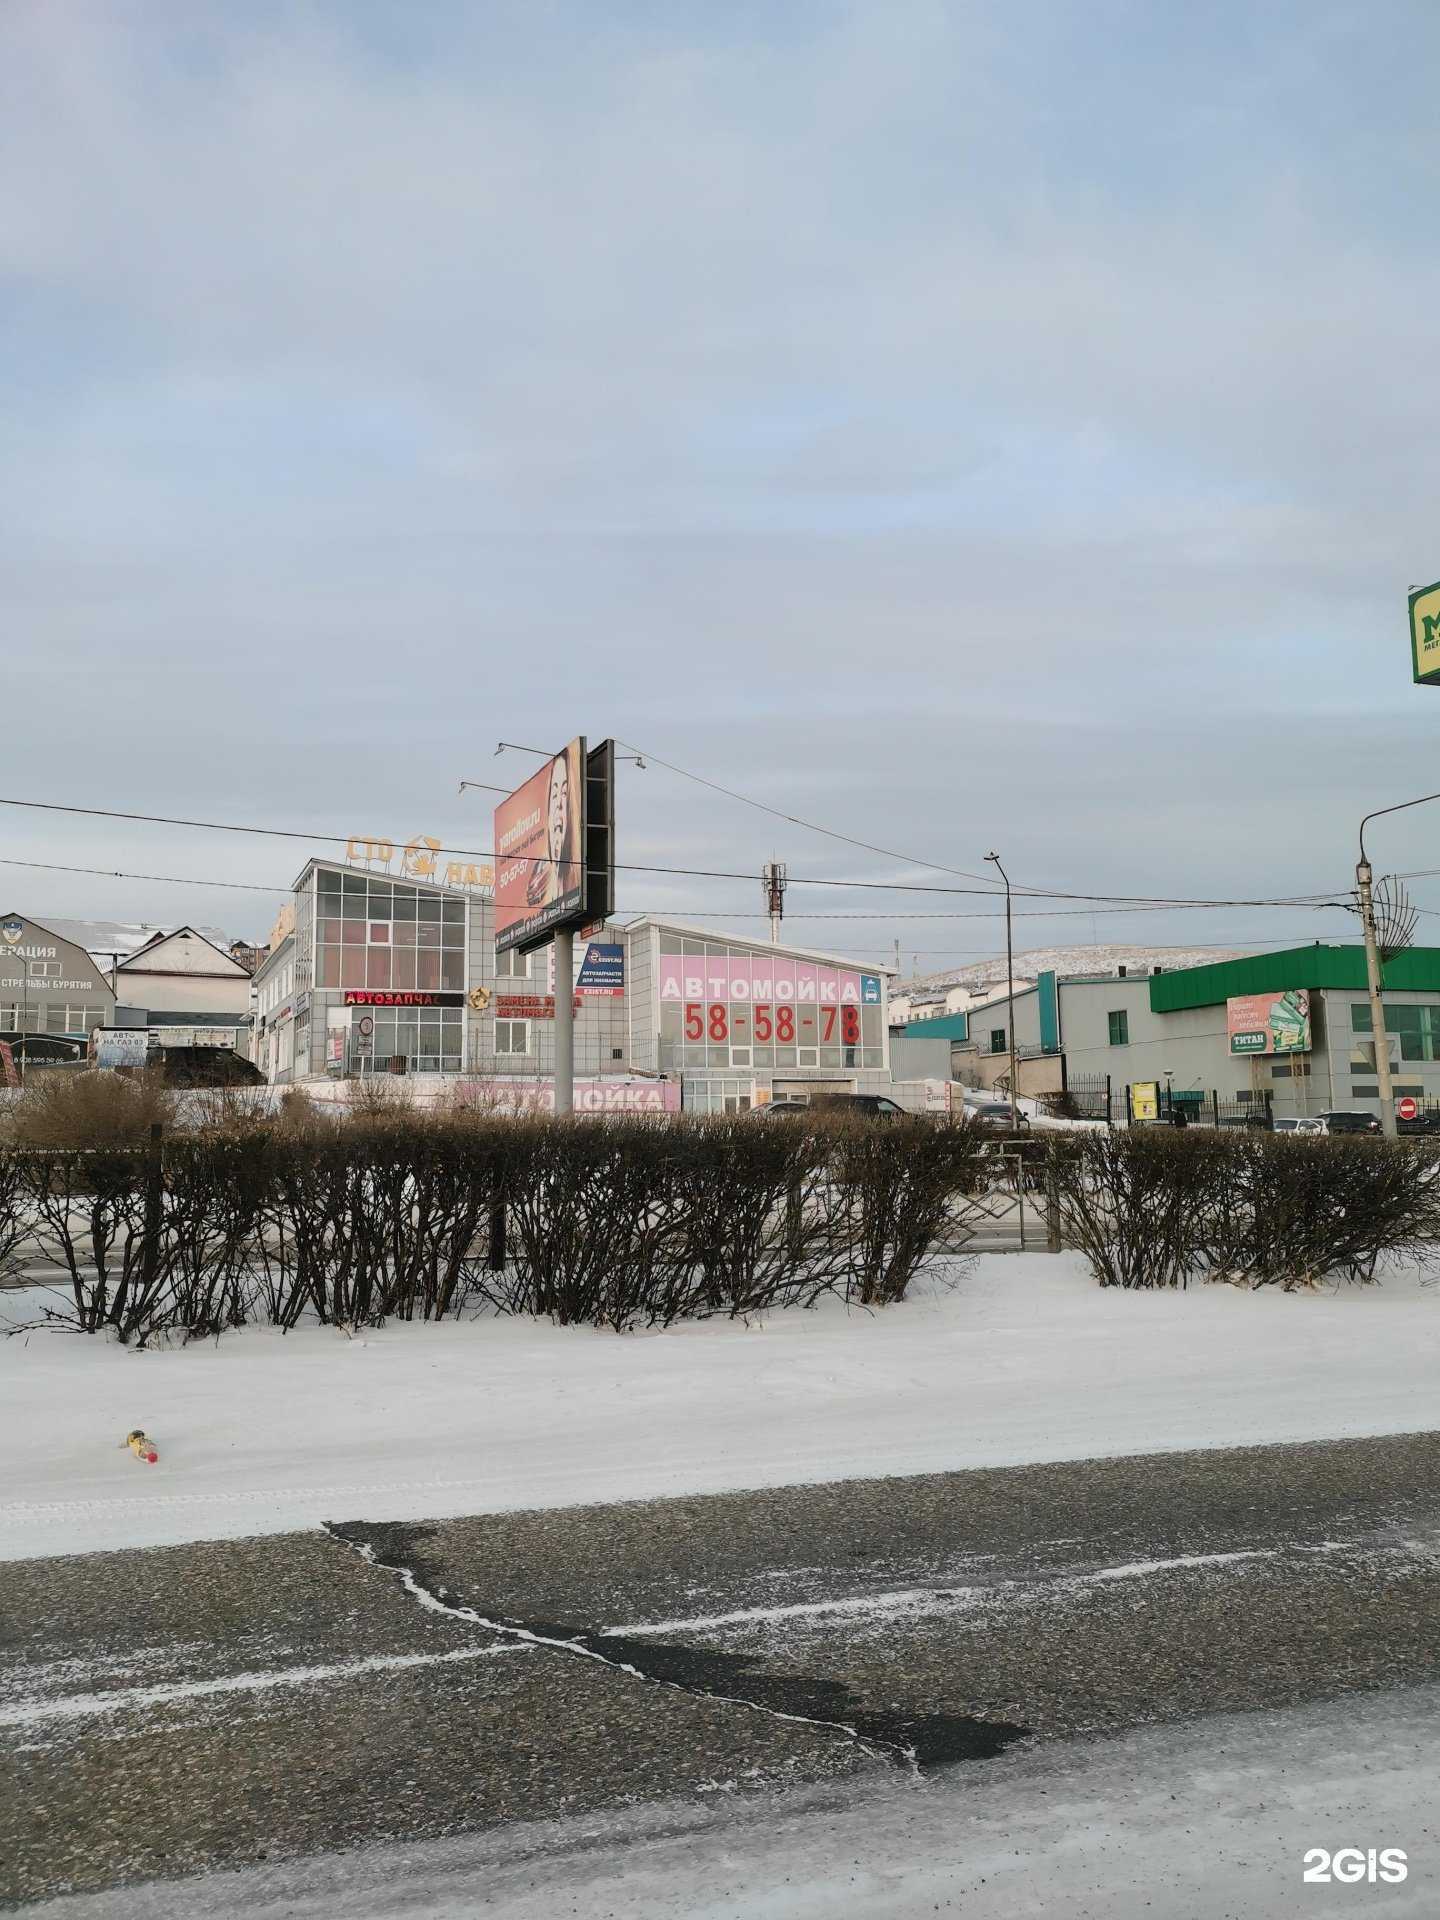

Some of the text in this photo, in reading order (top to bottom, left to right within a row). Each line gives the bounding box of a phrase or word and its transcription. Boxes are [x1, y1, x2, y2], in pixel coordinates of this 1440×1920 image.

[347, 837, 393, 862] СТО
[1, 978, 92, 990] СТРЕЛЬБЫ БУРЯТИЯ
[662, 976, 861, 1002] АВТОМОЙКА
[685, 1003, 860, 1044] 58-58-78
[1234, 1034, 1264, 1045] ТИТАН
